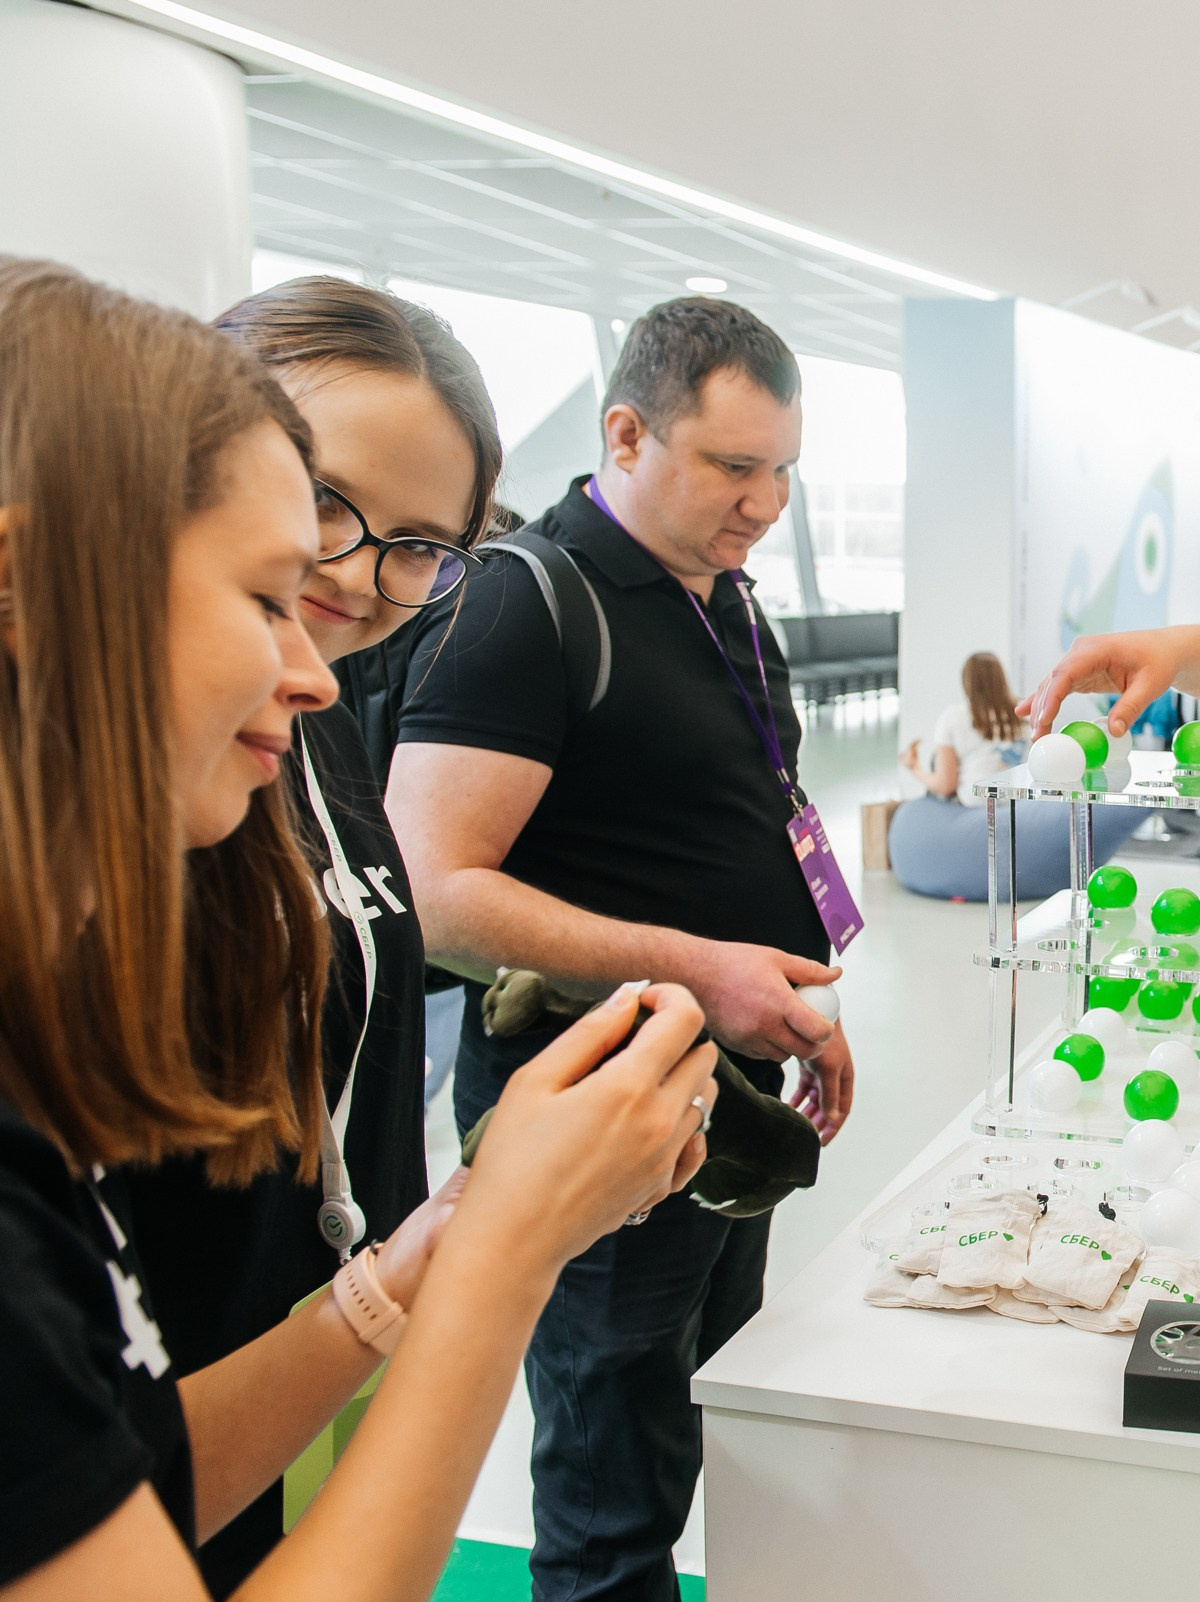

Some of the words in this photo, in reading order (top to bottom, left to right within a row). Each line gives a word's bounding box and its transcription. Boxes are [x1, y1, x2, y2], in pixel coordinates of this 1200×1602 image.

[329, 832, 342, 862] СБЕР
[360, 928, 372, 959] СБЕР
[959, 1231, 998, 1247] СБЕР
[1060, 1234, 1100, 1251] СБЕР
[1140, 1275, 1180, 1295] СБЕР
